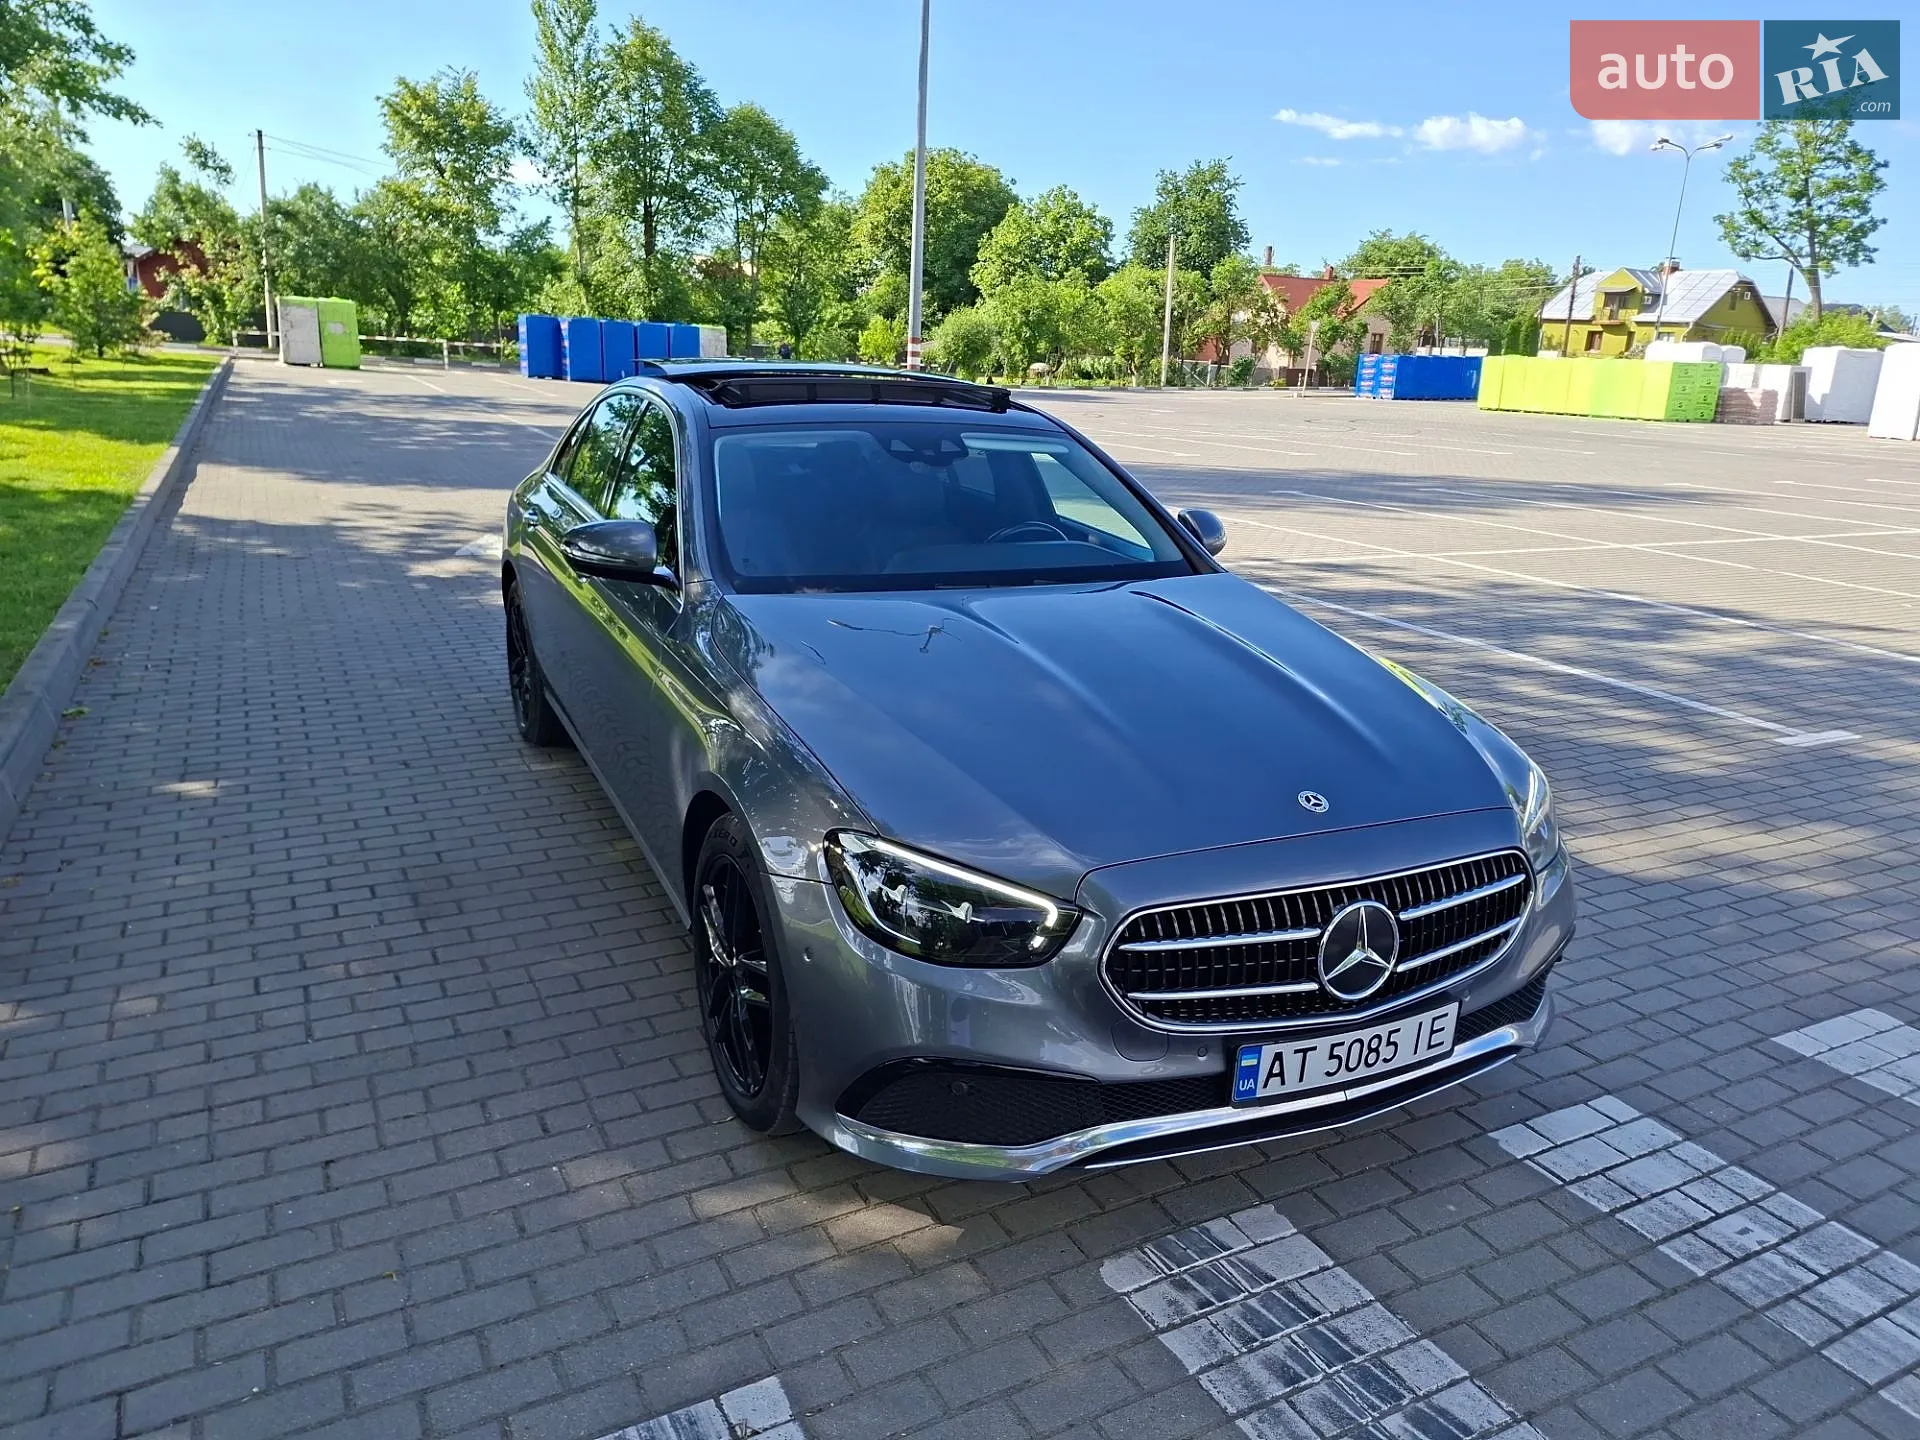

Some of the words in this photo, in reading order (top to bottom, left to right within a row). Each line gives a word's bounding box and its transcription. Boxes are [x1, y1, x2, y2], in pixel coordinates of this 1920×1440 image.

[1262, 1046, 1317, 1089] AT
[1324, 1028, 1401, 1077] 5085
[1413, 1012, 1449, 1055] IE
[1239, 1079, 1255, 1091] UA
